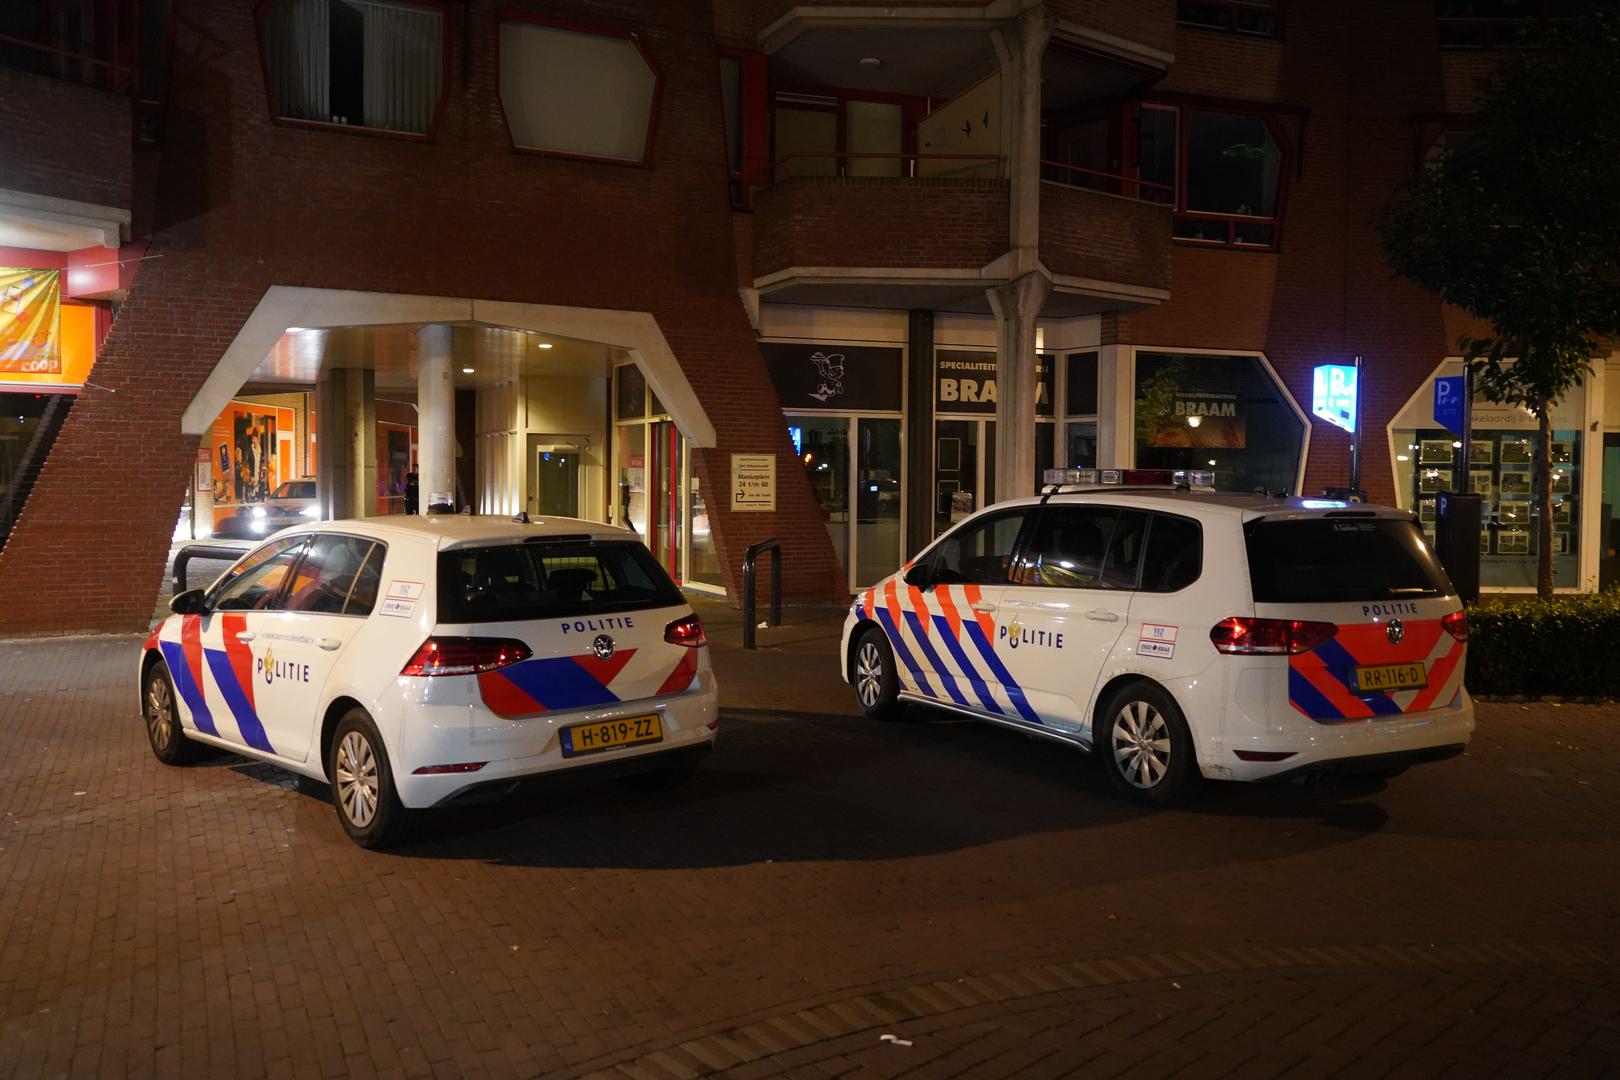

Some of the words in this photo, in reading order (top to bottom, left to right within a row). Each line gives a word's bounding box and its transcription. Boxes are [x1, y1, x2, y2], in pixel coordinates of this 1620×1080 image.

[940, 378, 1049, 403] BRA
[1437, 381, 1451, 405] P
[1175, 401, 1236, 416] BRAAM
[1361, 603, 1418, 616] POLITIE
[561, 617, 634, 634] POLITIE
[1000, 625, 1064, 649] POLITIE
[257, 657, 310, 685] POLITIE
[1364, 667, 1418, 687] RR-116-D
[581, 718, 653, 747] H-819-ZZ
